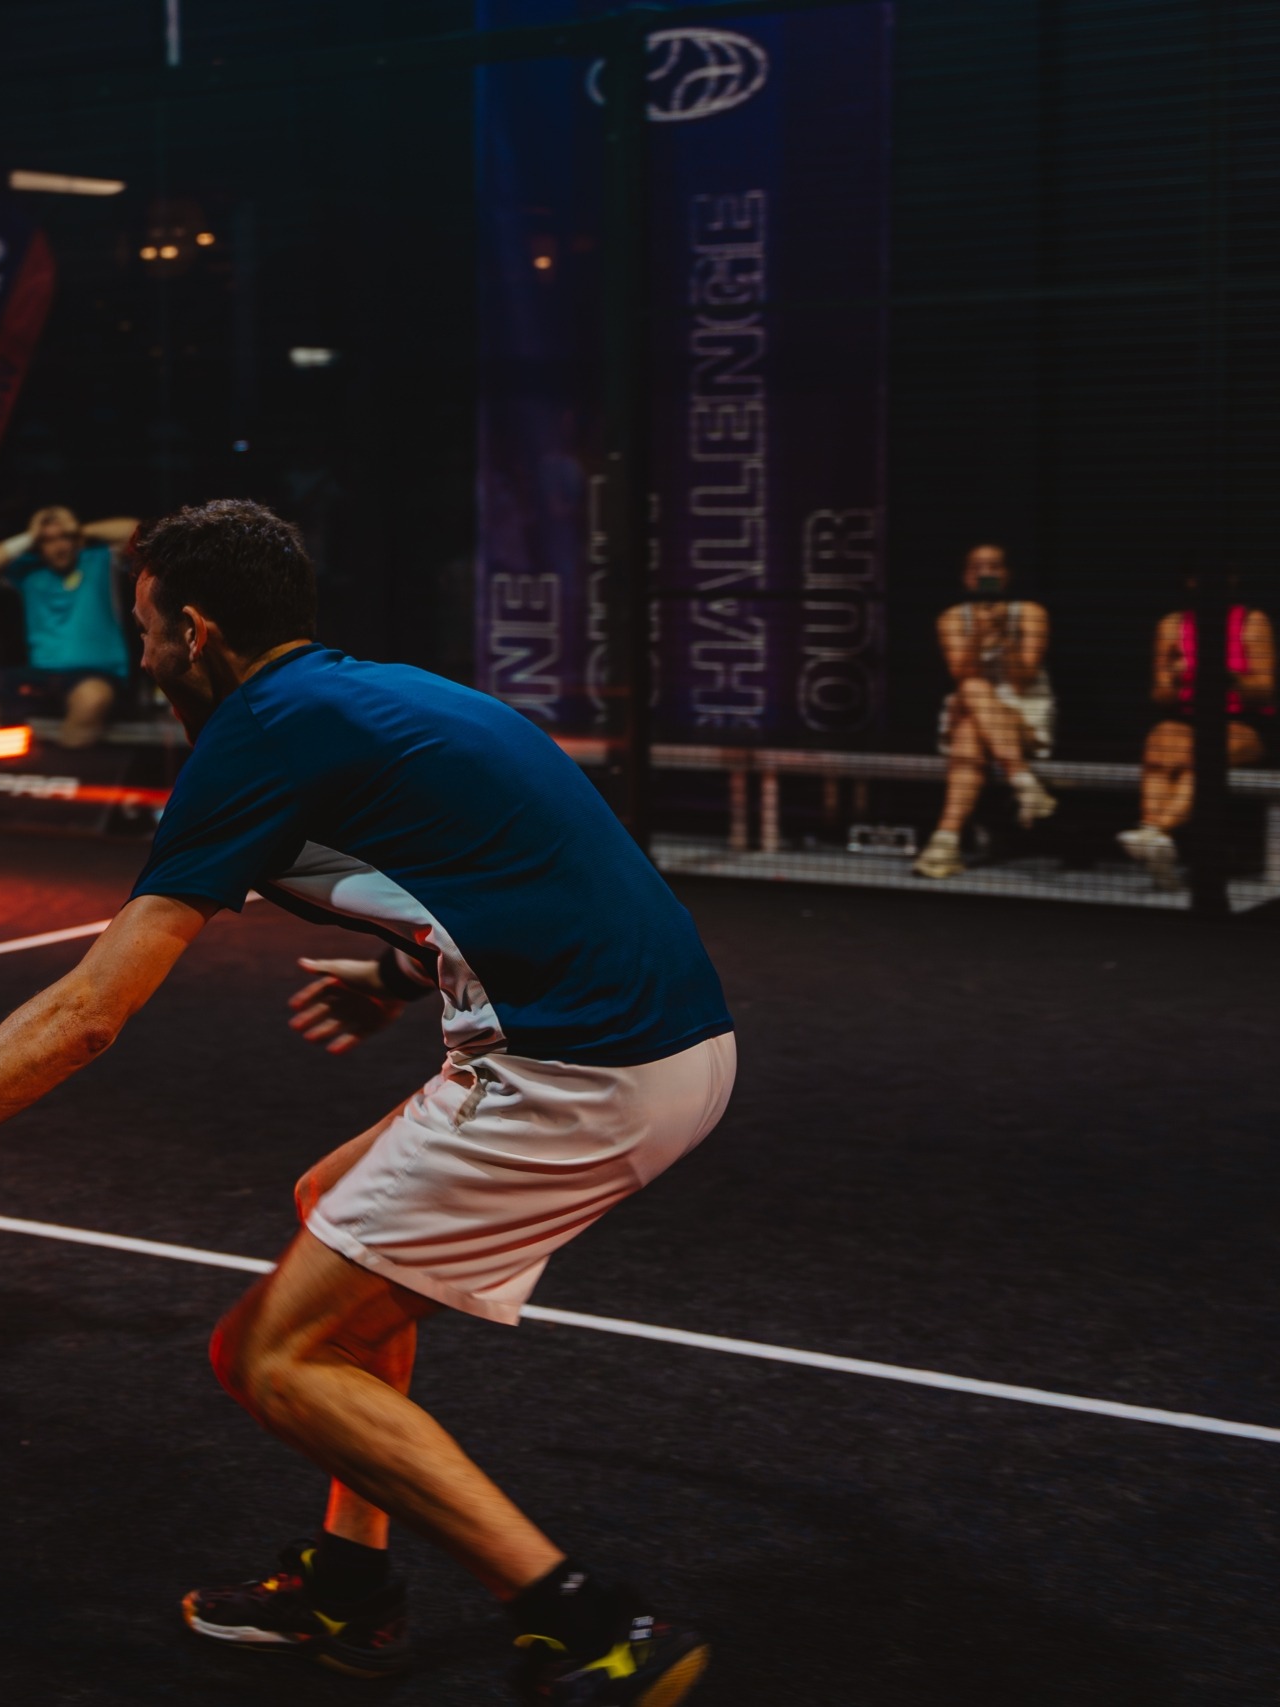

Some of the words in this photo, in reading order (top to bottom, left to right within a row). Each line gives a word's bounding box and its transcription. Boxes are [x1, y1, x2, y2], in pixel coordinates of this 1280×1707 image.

[690, 189, 766, 729] HALLENGE
[490, 572, 562, 721] NE
[800, 507, 877, 733] OUR
